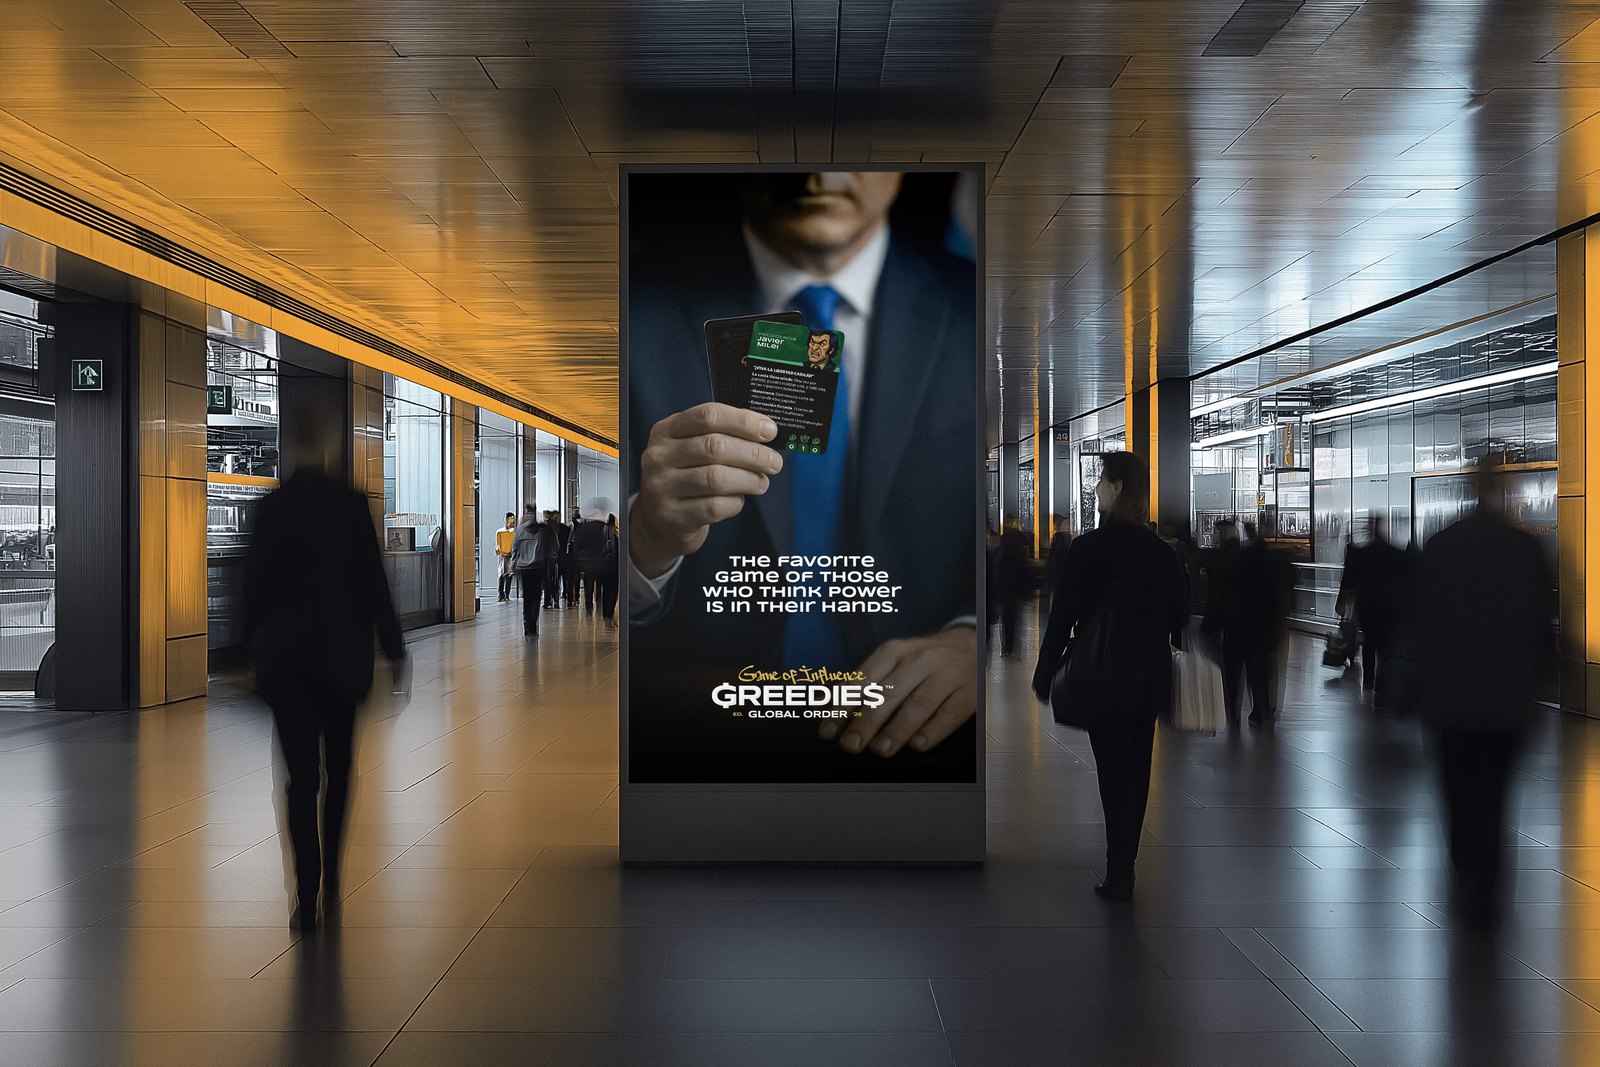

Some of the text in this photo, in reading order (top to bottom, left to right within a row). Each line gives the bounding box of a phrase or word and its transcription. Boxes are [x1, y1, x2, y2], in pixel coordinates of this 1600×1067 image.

[729, 555, 771, 568] THE
[785, 571, 814, 583] OF
[819, 570, 889, 583] THOSE
[702, 586, 754, 598] WHO
[759, 586, 822, 598] THINK
[706, 601, 724, 613] IS
[756, 601, 816, 613] THEIR
[738, 664, 867, 685] Game of Influence
[748, 710, 801, 719] GLOBAL
[803, 710, 848, 719] ORDER
